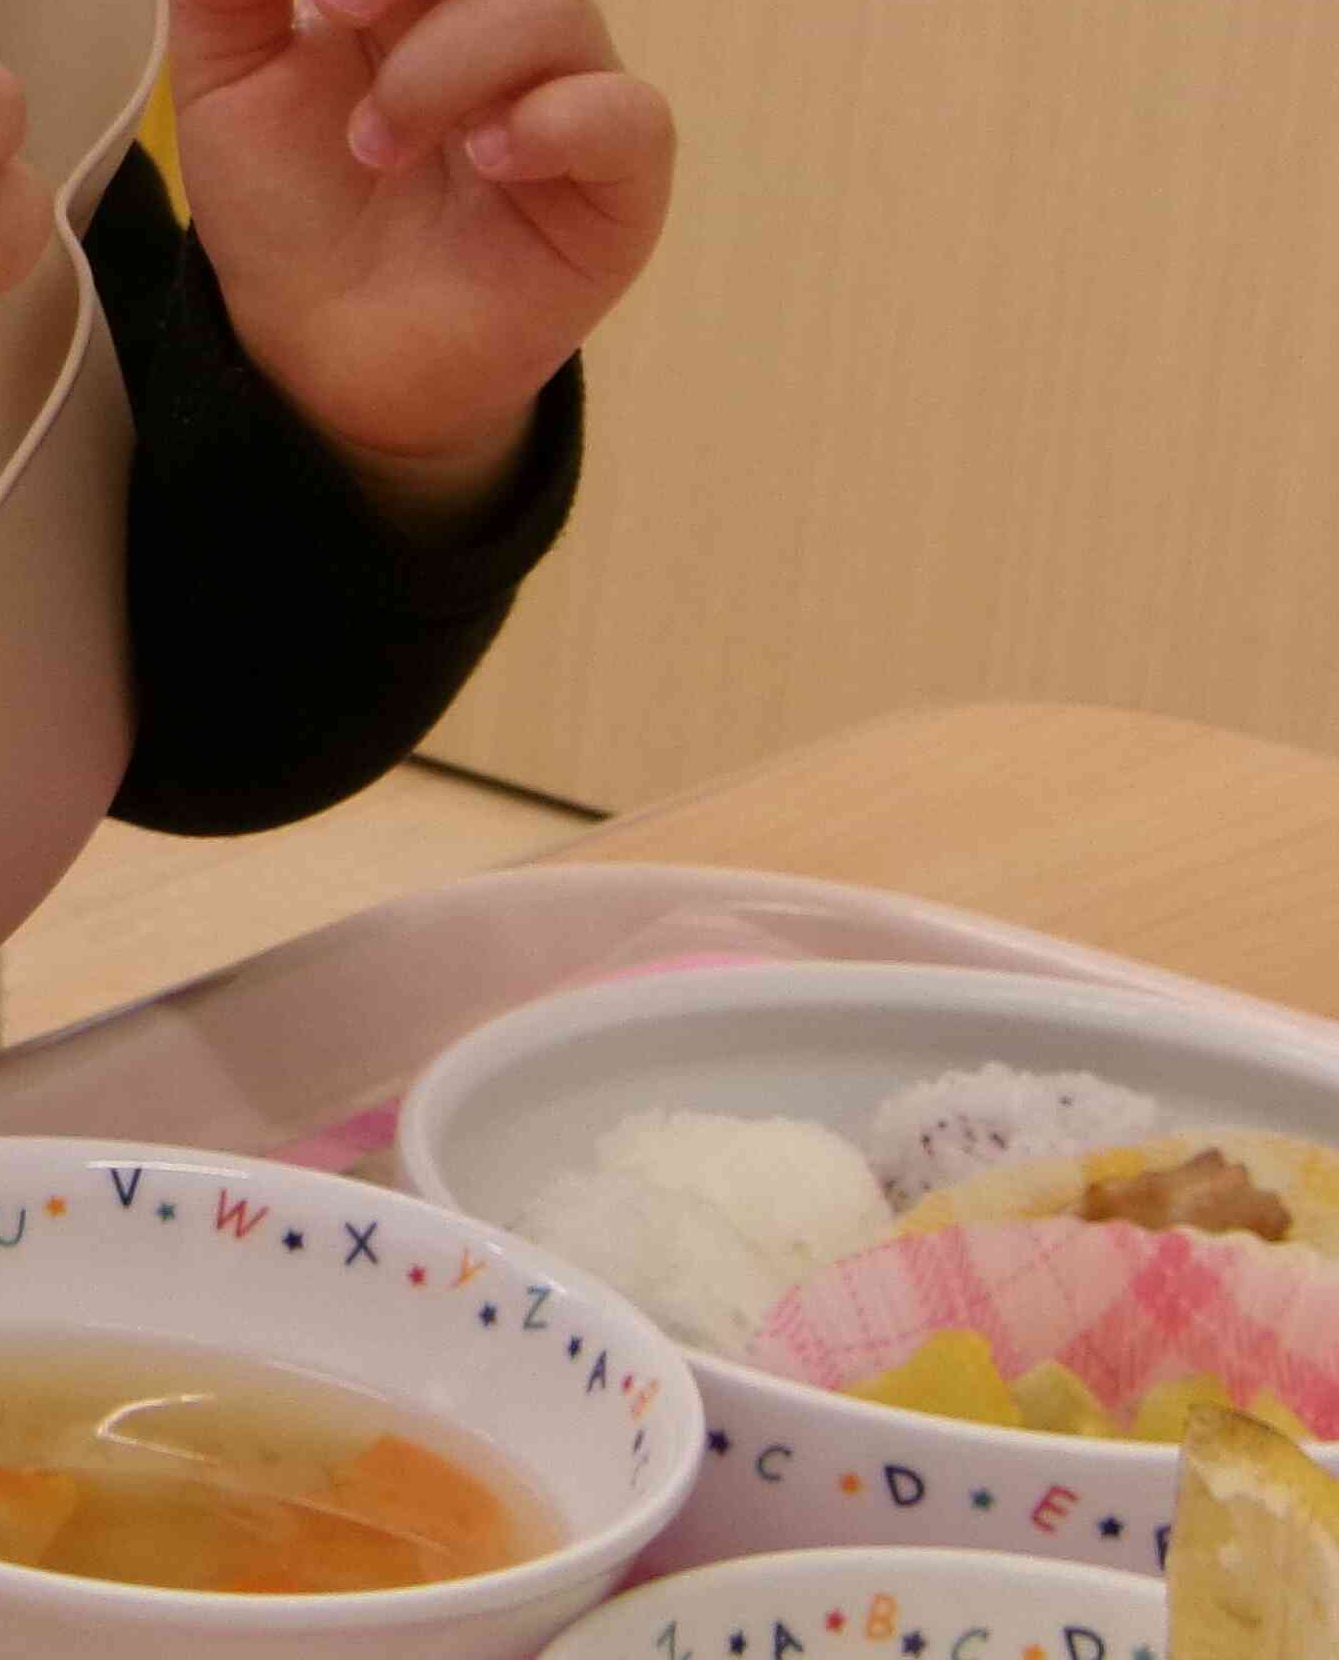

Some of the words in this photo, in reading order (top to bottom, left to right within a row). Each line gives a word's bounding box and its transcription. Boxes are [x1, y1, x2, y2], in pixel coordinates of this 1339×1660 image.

[110, 1168, 143, 1207] V
[215, 1188, 270, 1239] W
[344, 1221, 378, 1266] X
[451, 1245, 490, 1288] Y
[522, 1285, 553, 1330] Z
[587, 1348, 607, 1394] A
[755, 1444, 794, 1483] C
[883, 1463, 925, 1507] D
[1031, 1484, 1080, 1534] E
[772, 1619, 805, 1660] A
[863, 1592, 898, 1644] B
[1063, 1624, 1106, 1660] D
